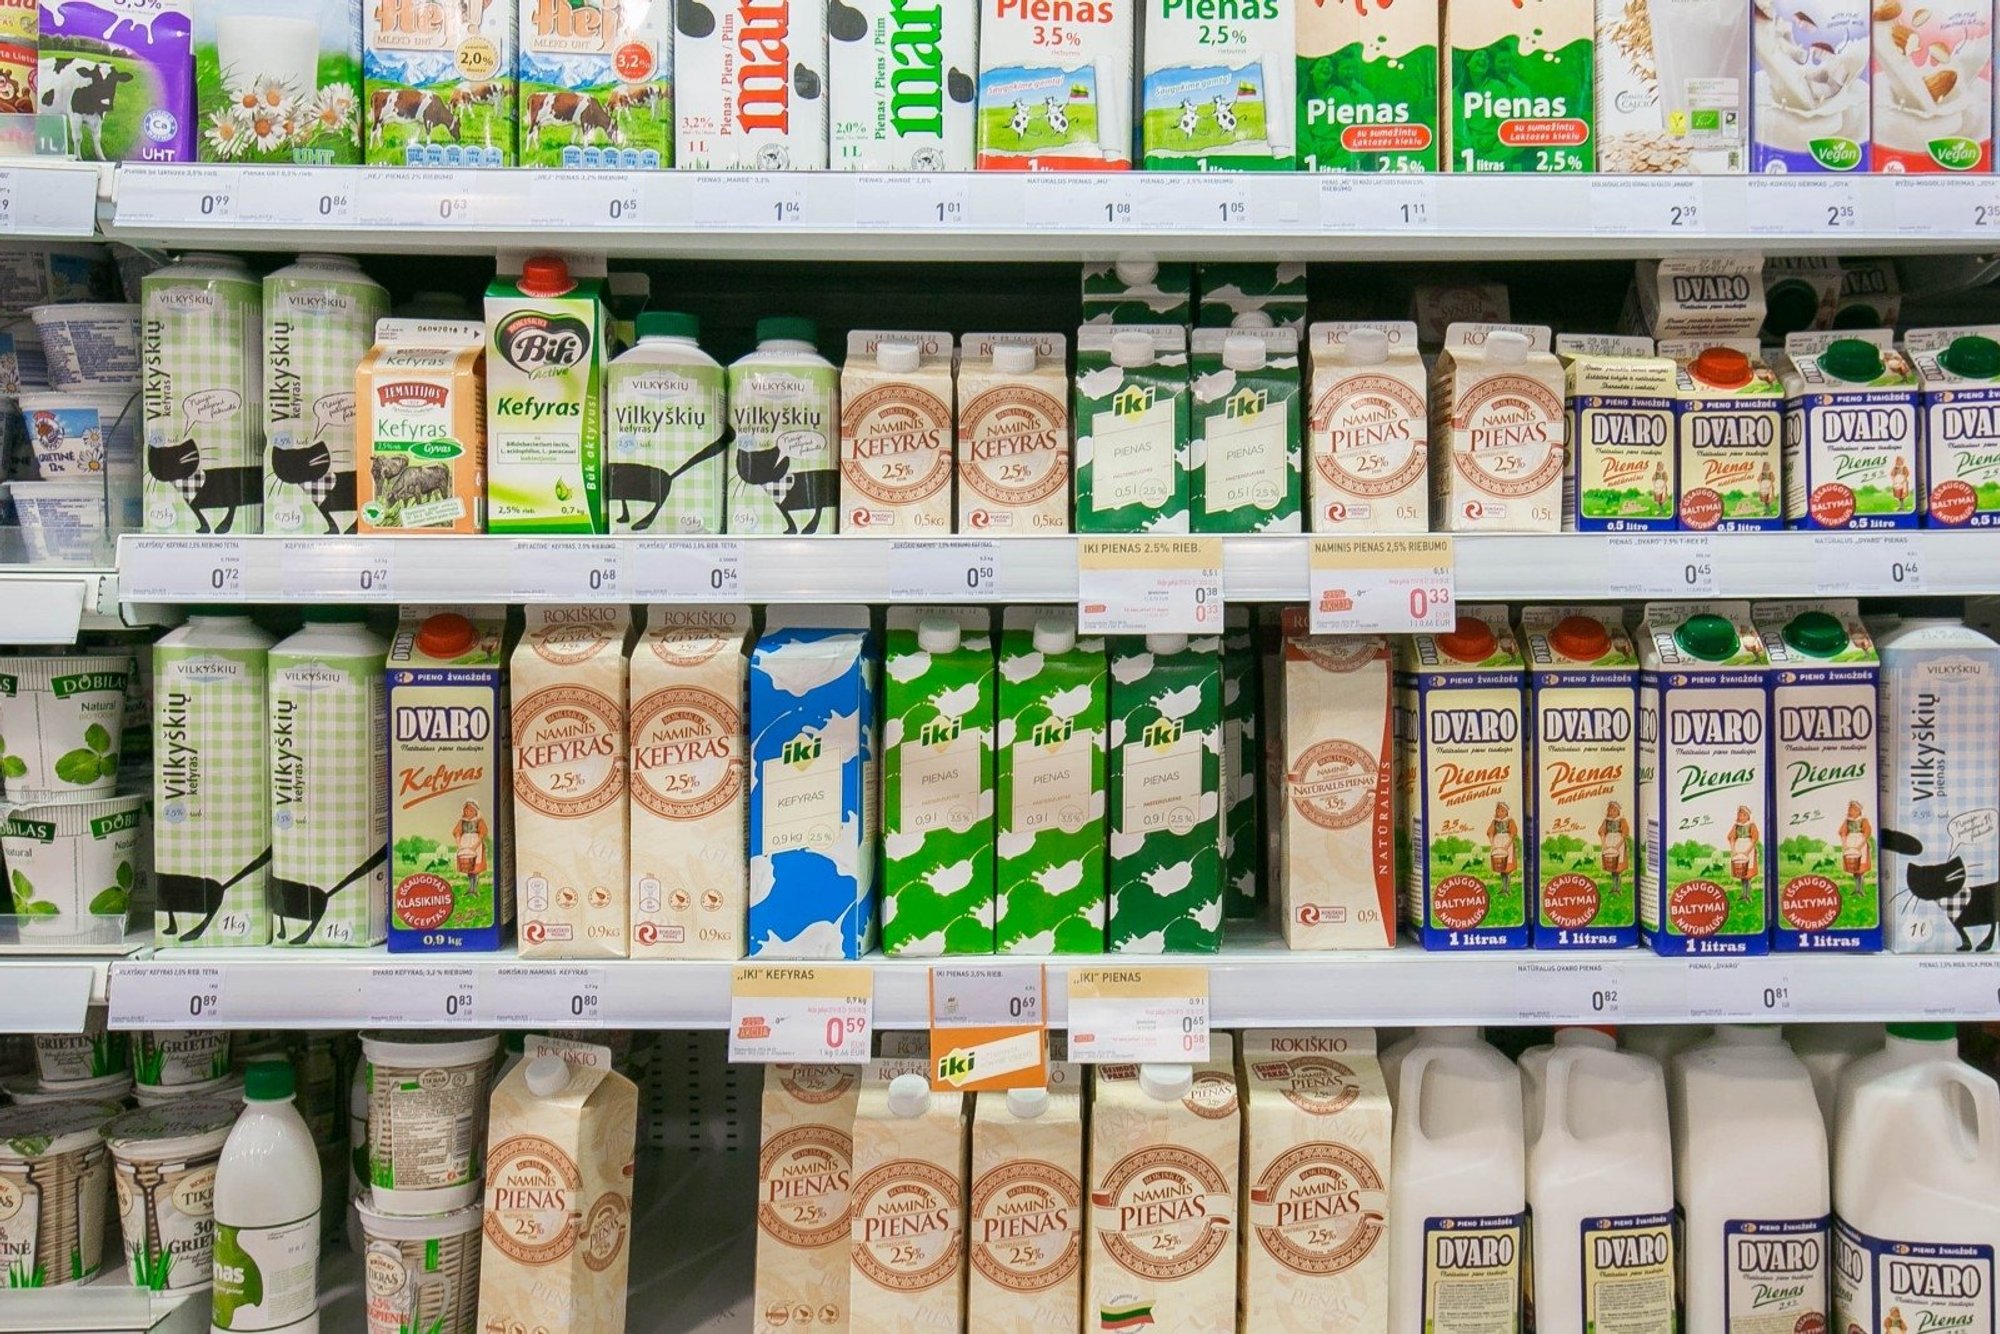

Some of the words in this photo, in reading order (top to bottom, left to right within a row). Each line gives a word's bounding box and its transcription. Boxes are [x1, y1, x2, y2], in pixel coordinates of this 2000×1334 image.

[1307, 99, 1409, 125] Pienas
[1464, 92, 1567, 119] Pienas
[143, 148, 175, 161] UHT
[1818, 147, 1857, 163] Vegan
[1937, 147, 1977, 163] Vegan
[1674, 275, 1749, 301] DVARO
[514, 334, 576, 364] Bifi
[147, 321, 171, 421] Vilkyškių
[271, 322, 300, 422] Vilkyškių
[497, 396, 580, 419] Kefyras
[1114, 389, 1153, 416] iki
[1227, 392, 1265, 419] iki
[616, 407, 705, 432] Vilkyškių
[735, 406, 821, 432] Vilkyškių
[870, 417, 924, 434] NAMINIS
[987, 418, 1041, 436] NAMINIS
[1343, 409, 1398, 427] NAMINIS
[1483, 409, 1536, 427] NAMINIS
[1823, 408, 1907, 442] DVARO
[378, 419, 447, 440] Kefyras
[1331, 419, 1409, 452] PIENAS
[1471, 421, 1547, 452] PIENAS
[1592, 414, 1666, 446] DVARO
[1693, 416, 1773, 447] DVARO
[424, 444, 451, 456] Gyvas
[852, 429, 940, 460] KEFYRAS
[971, 430, 1057, 461] KEFYRAS
[1114, 442, 1151, 458] PIENAS
[1227, 445, 1264, 460] PIENAS
[1601, 457, 1649, 478] Pienas
[1702, 459, 1753, 480] Pienas
[1834, 454, 1888, 475] Pienas
[1682, 502, 1721, 515] BALTYMAI
[1812, 498, 1852, 512] BALTYMAI
[1626, 523, 1647, 531] litro
[1738, 523, 1761, 532] litro
[1871, 518, 1895, 528] litro
[1084, 543, 1098, 553] IKI
[1102, 543, 1141, 553] PIENAS
[1173, 543, 1201, 553] RIEB.
[1315, 542, 1351, 553] NAMINIS
[1354, 542, 1385, 552] PIENAS
[1409, 541, 1447, 551] RIEBUMO
[543, 607, 616, 623] ROKIŠKIO
[664, 611, 736, 626] ROKIŠKIO
[417, 673, 442, 681] PIENO
[1563, 676, 1586, 684] PIENO
[1691, 676, 1716, 684] PIENO
[397, 706, 489, 741] DVARO
[536, 722, 596, 740] NAMINIS
[652, 723, 711, 742] NAMINIS
[922, 718, 960, 747] iki
[1034, 719, 1072, 747] iki
[1431, 708, 1517, 743] DVARO
[1544, 708, 1630, 742] DVARO
[1671, 709, 1761, 744] DVARO
[1781, 706, 1872, 742] DVARO
[163, 693, 197, 799] Vilkyškių
[1145, 722, 1181, 748] iki
[274, 700, 302, 805] Vilkyškių
[518, 733, 613, 770] KEFYRAS
[635, 736, 730, 770] KEFYRAS
[784, 737, 821, 765] iki
[1911, 694, 1945, 801] Vilkyškių
[399, 764, 483, 796] Kefyras
[922, 769, 959, 786] PIENAS
[1034, 770, 1071, 785] PIENAS
[1143, 771, 1180, 787] PIENAS
[1435, 763, 1510, 793] Pienas
[1547, 761, 1622, 792] Pienas
[1677, 765, 1754, 795] Pienas
[1787, 761, 1866, 791] Pienas
[1937, 759, 1946, 797] pienas
[778, 790, 824, 808] KEFYRAS
[1379, 760, 1390, 875] NATŪRALUS
[397, 895, 452, 908] KLASIKINIS
[1435, 896, 1486, 909] BALTYMAI
[1545, 895, 1596, 908] BALTYMAI
[1672, 902, 1725, 915] BALTYMAI
[1783, 898, 1838, 910] BALTYMAI
[1463, 933, 1507, 945] litras
[1573, 932, 1617, 943] litras
[1701, 940, 1746, 952] litras
[1814, 935, 1860, 947] litras
[766, 970, 814, 980] KEFYRAS
[1102, 972, 1141, 982] PIENAS
[1271, 1037, 1347, 1052] ROKIŠKIO
[940, 1052, 975, 1078] iki
[1291, 1075, 1343, 1090] PIENAS
[782, 1160, 838, 1177] NAMINIS
[507, 1175, 556, 1187] NAMINIS
[770, 1171, 849, 1202] PIENAS
[1289, 1179, 1348, 1198] NAMINIS
[495, 1188, 565, 1211] PIENAS
[1133, 1182, 1193, 1203] NAMINIS
[877, 1198, 936, 1215] NAMINIS
[997, 1198, 1055, 1216] NAMINIS
[1120, 1194, 1205, 1231] PIENAS
[1277, 1191, 1360, 1227] PIENAS
[865, 1208, 949, 1242] PIENAS
[984, 1208, 1067, 1242] PIENAS
[1437, 1234, 1514, 1269] DVARO
[1595, 1234, 1668, 1269] DVARO
[1738, 1239, 1819, 1273] DVARO
[1890, 1261, 1981, 1297] DVARO
[1752, 1284, 1804, 1307] Pienas
[1915, 1310, 1974, 1332] Pienas
